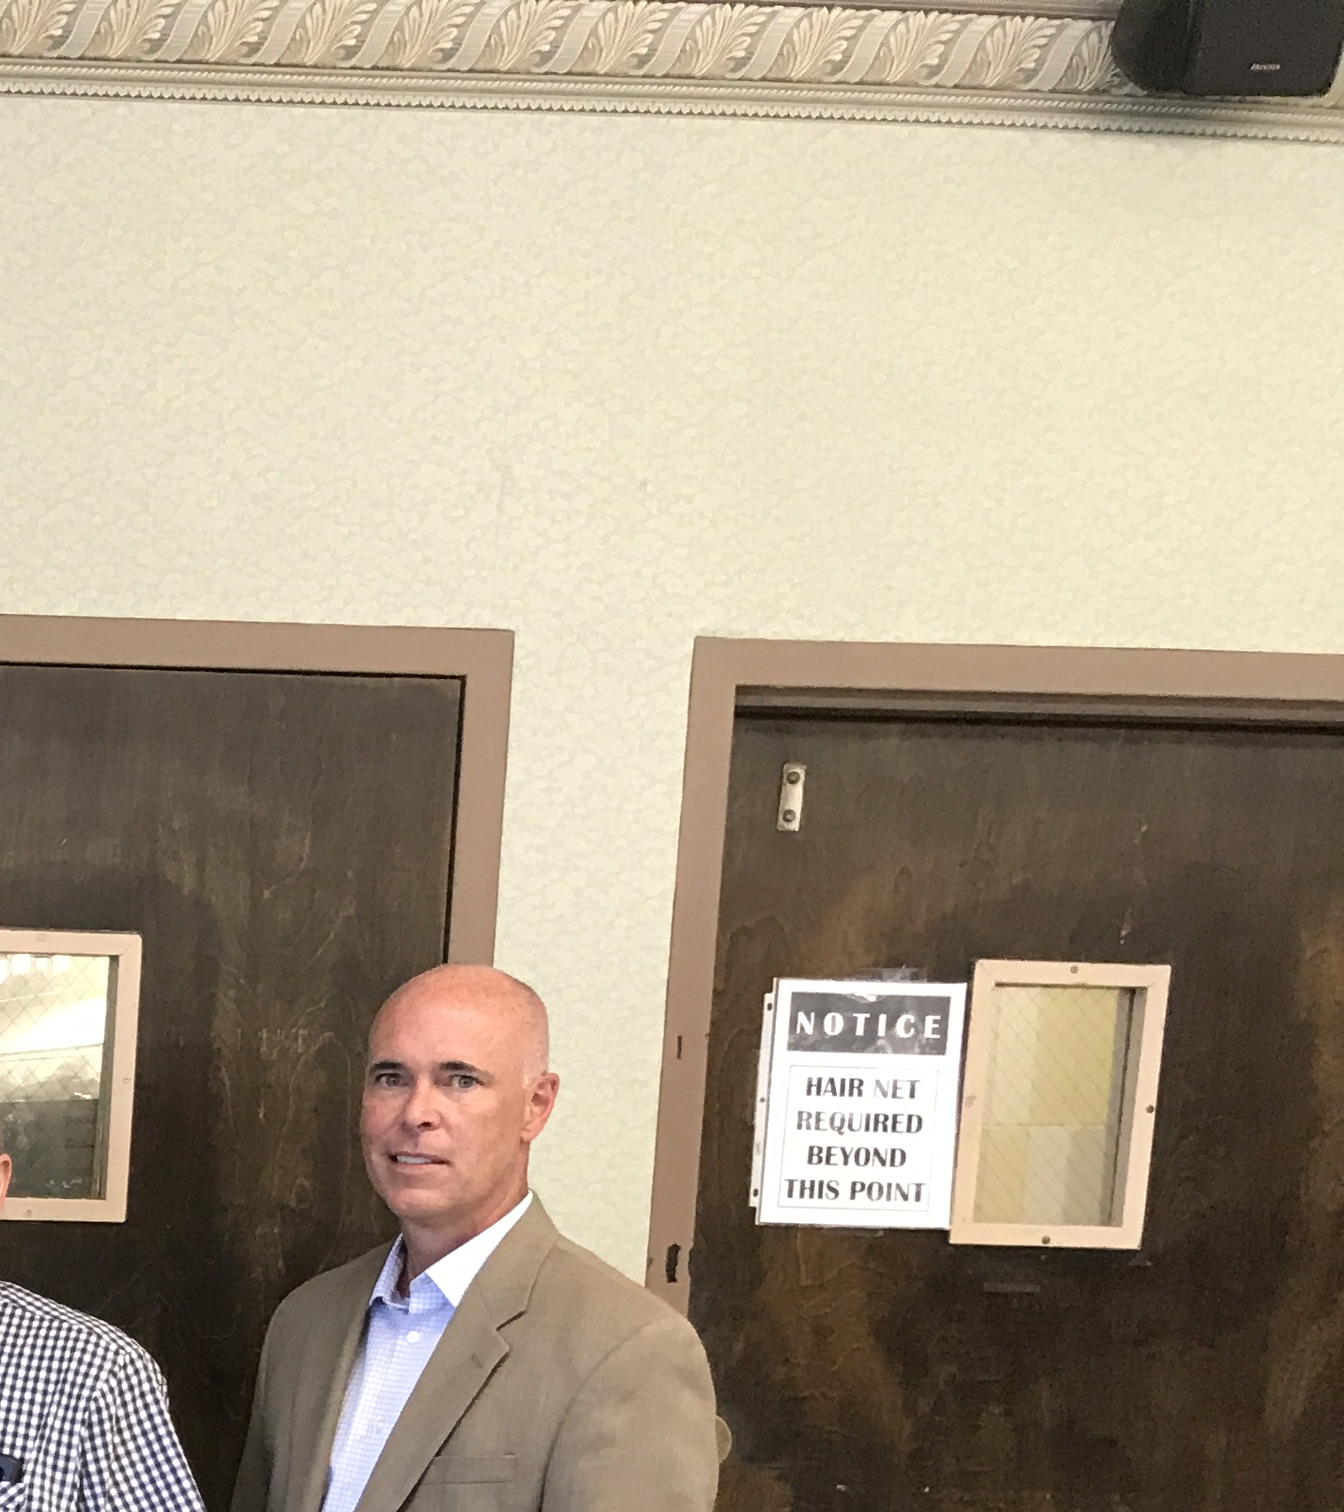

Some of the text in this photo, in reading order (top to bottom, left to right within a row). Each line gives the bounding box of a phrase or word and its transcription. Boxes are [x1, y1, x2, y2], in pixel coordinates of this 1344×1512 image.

[795, 1011, 941, 1039] NOTICE
[805, 1076, 921, 1100] HAIR NET
[796, 1110, 924, 1136] REQUIRED
[806, 1145, 907, 1168] BEYOND
[784, 1178, 926, 1203] THIS POINT
